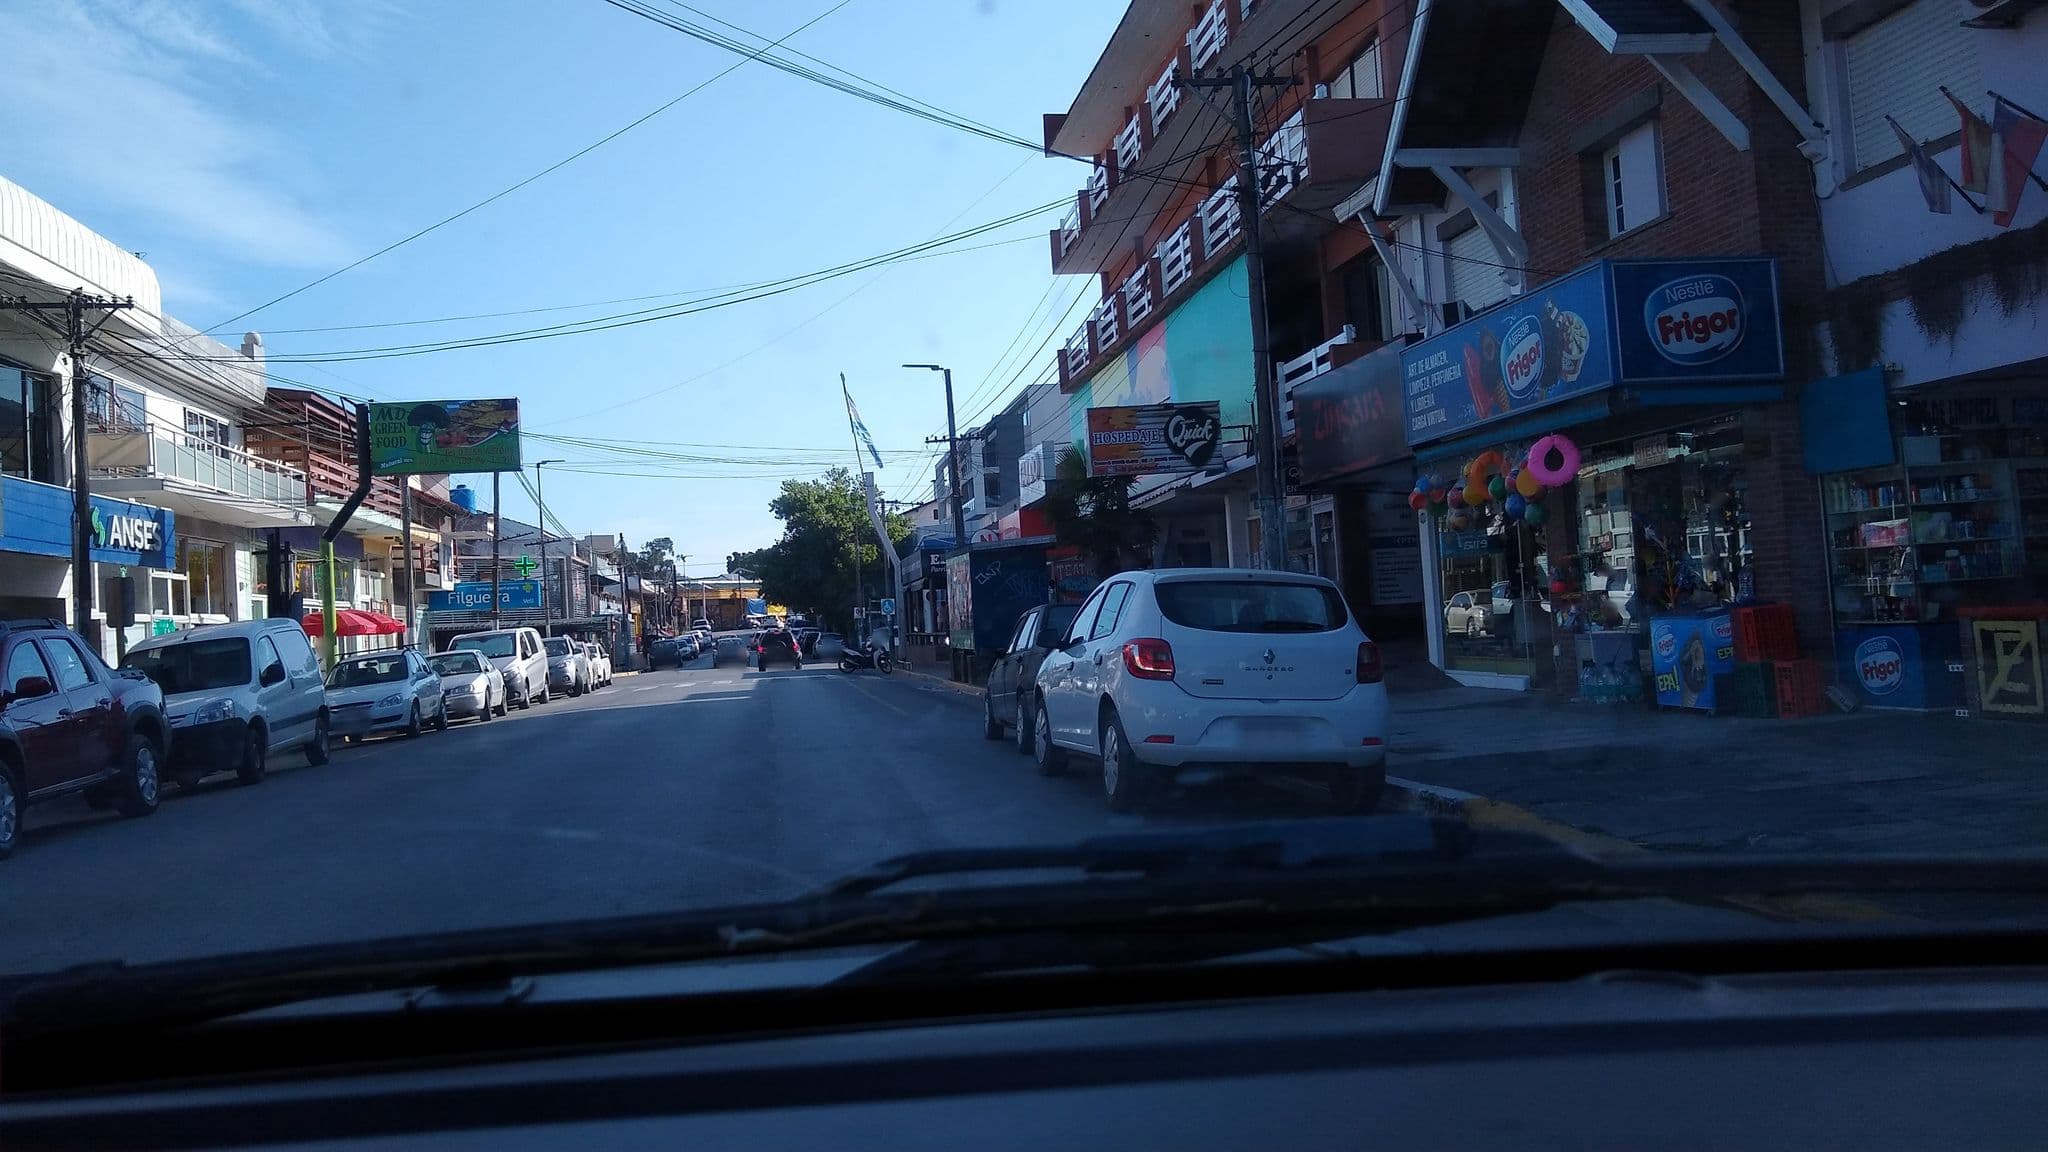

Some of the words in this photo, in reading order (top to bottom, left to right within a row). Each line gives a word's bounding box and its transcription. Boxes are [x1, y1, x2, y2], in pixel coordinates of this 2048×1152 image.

[1664, 278, 1716, 304] Nestlé
[1508, 320, 1531, 348] Nestlé
[1657, 308, 1738, 346] Frigor
[1507, 340, 1542, 385] Frigor
[375, 422, 406, 435] GREEN
[1093, 428, 1160, 446] HOSPEDAJE
[1168, 415, 1213, 448] Quick
[376, 436, 407, 449] FOOD
[109, 514, 163, 551] ANSES
[1861, 658, 1901, 682] Frigor
